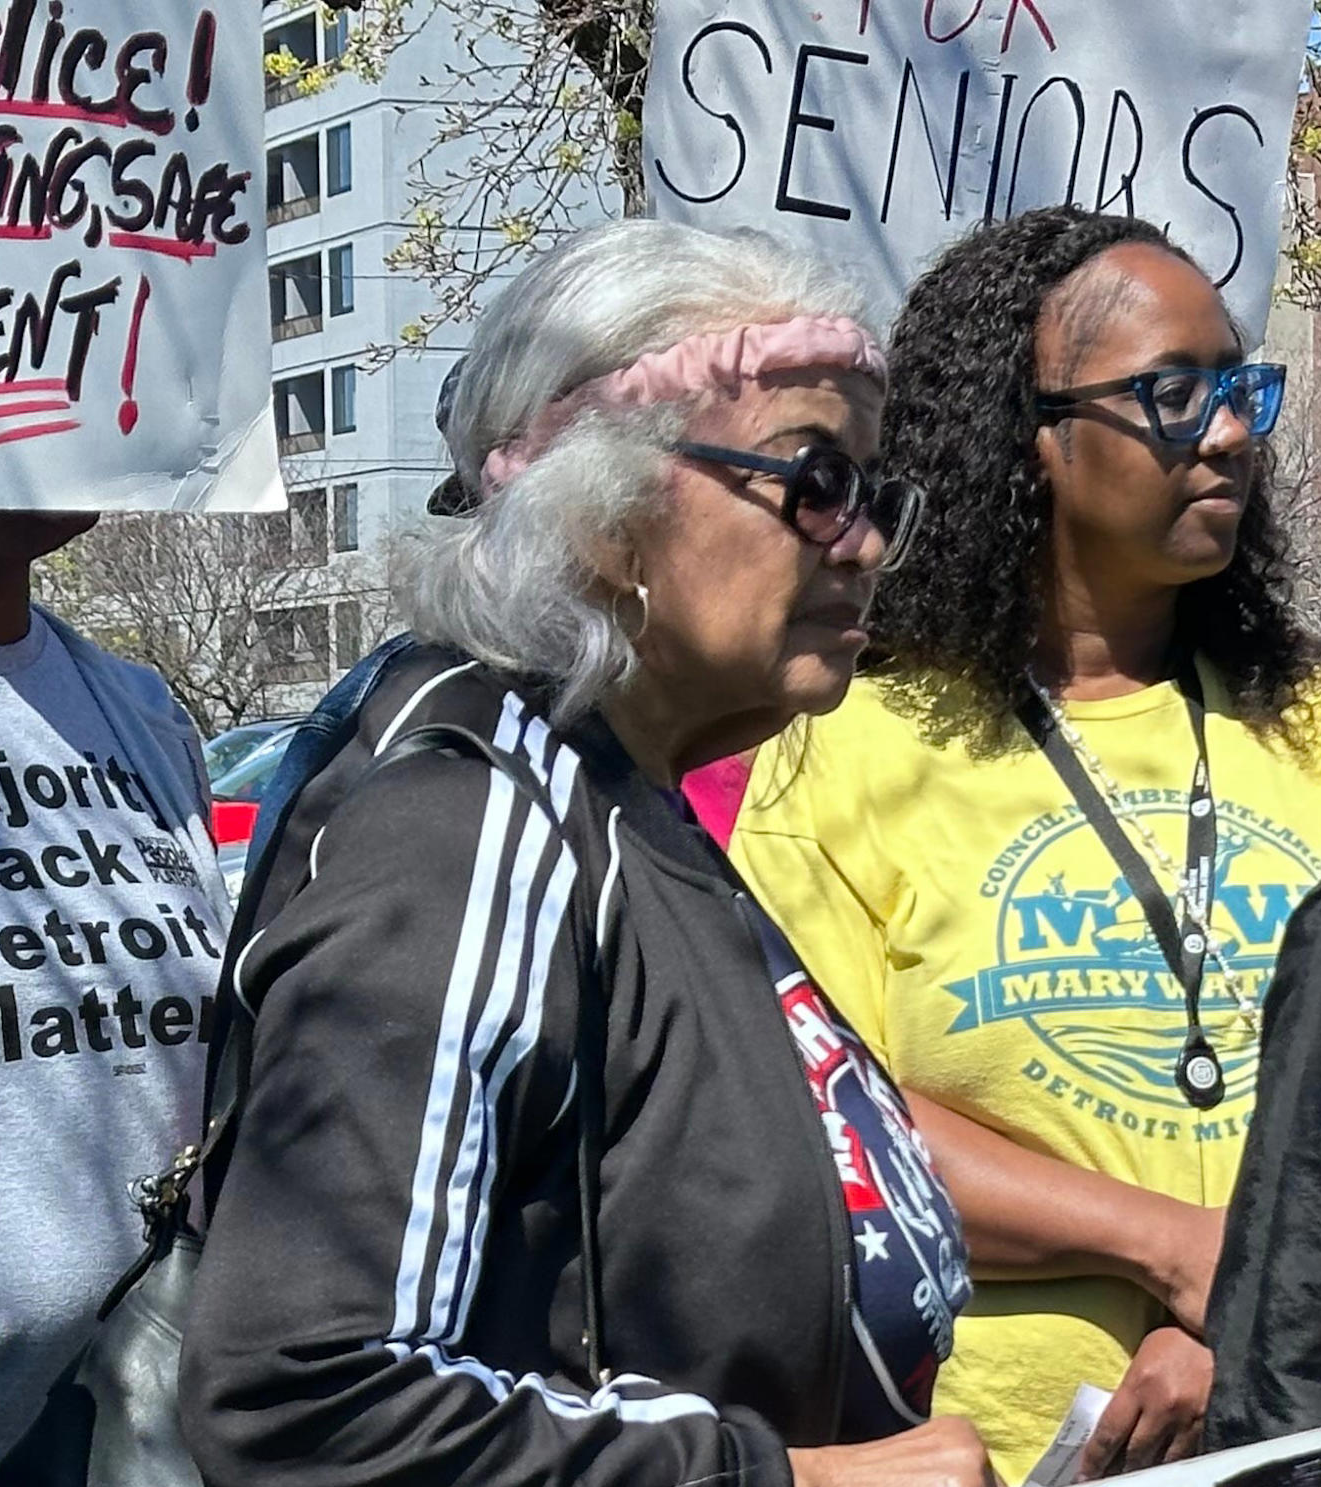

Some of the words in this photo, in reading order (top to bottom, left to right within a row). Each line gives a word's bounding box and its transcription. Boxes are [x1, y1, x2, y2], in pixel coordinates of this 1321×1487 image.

[980, 806, 1064, 898] COUNCIL
[1001, 966, 1149, 1006] MARY
[1021, 1057, 1181, 1142] DETROIT
